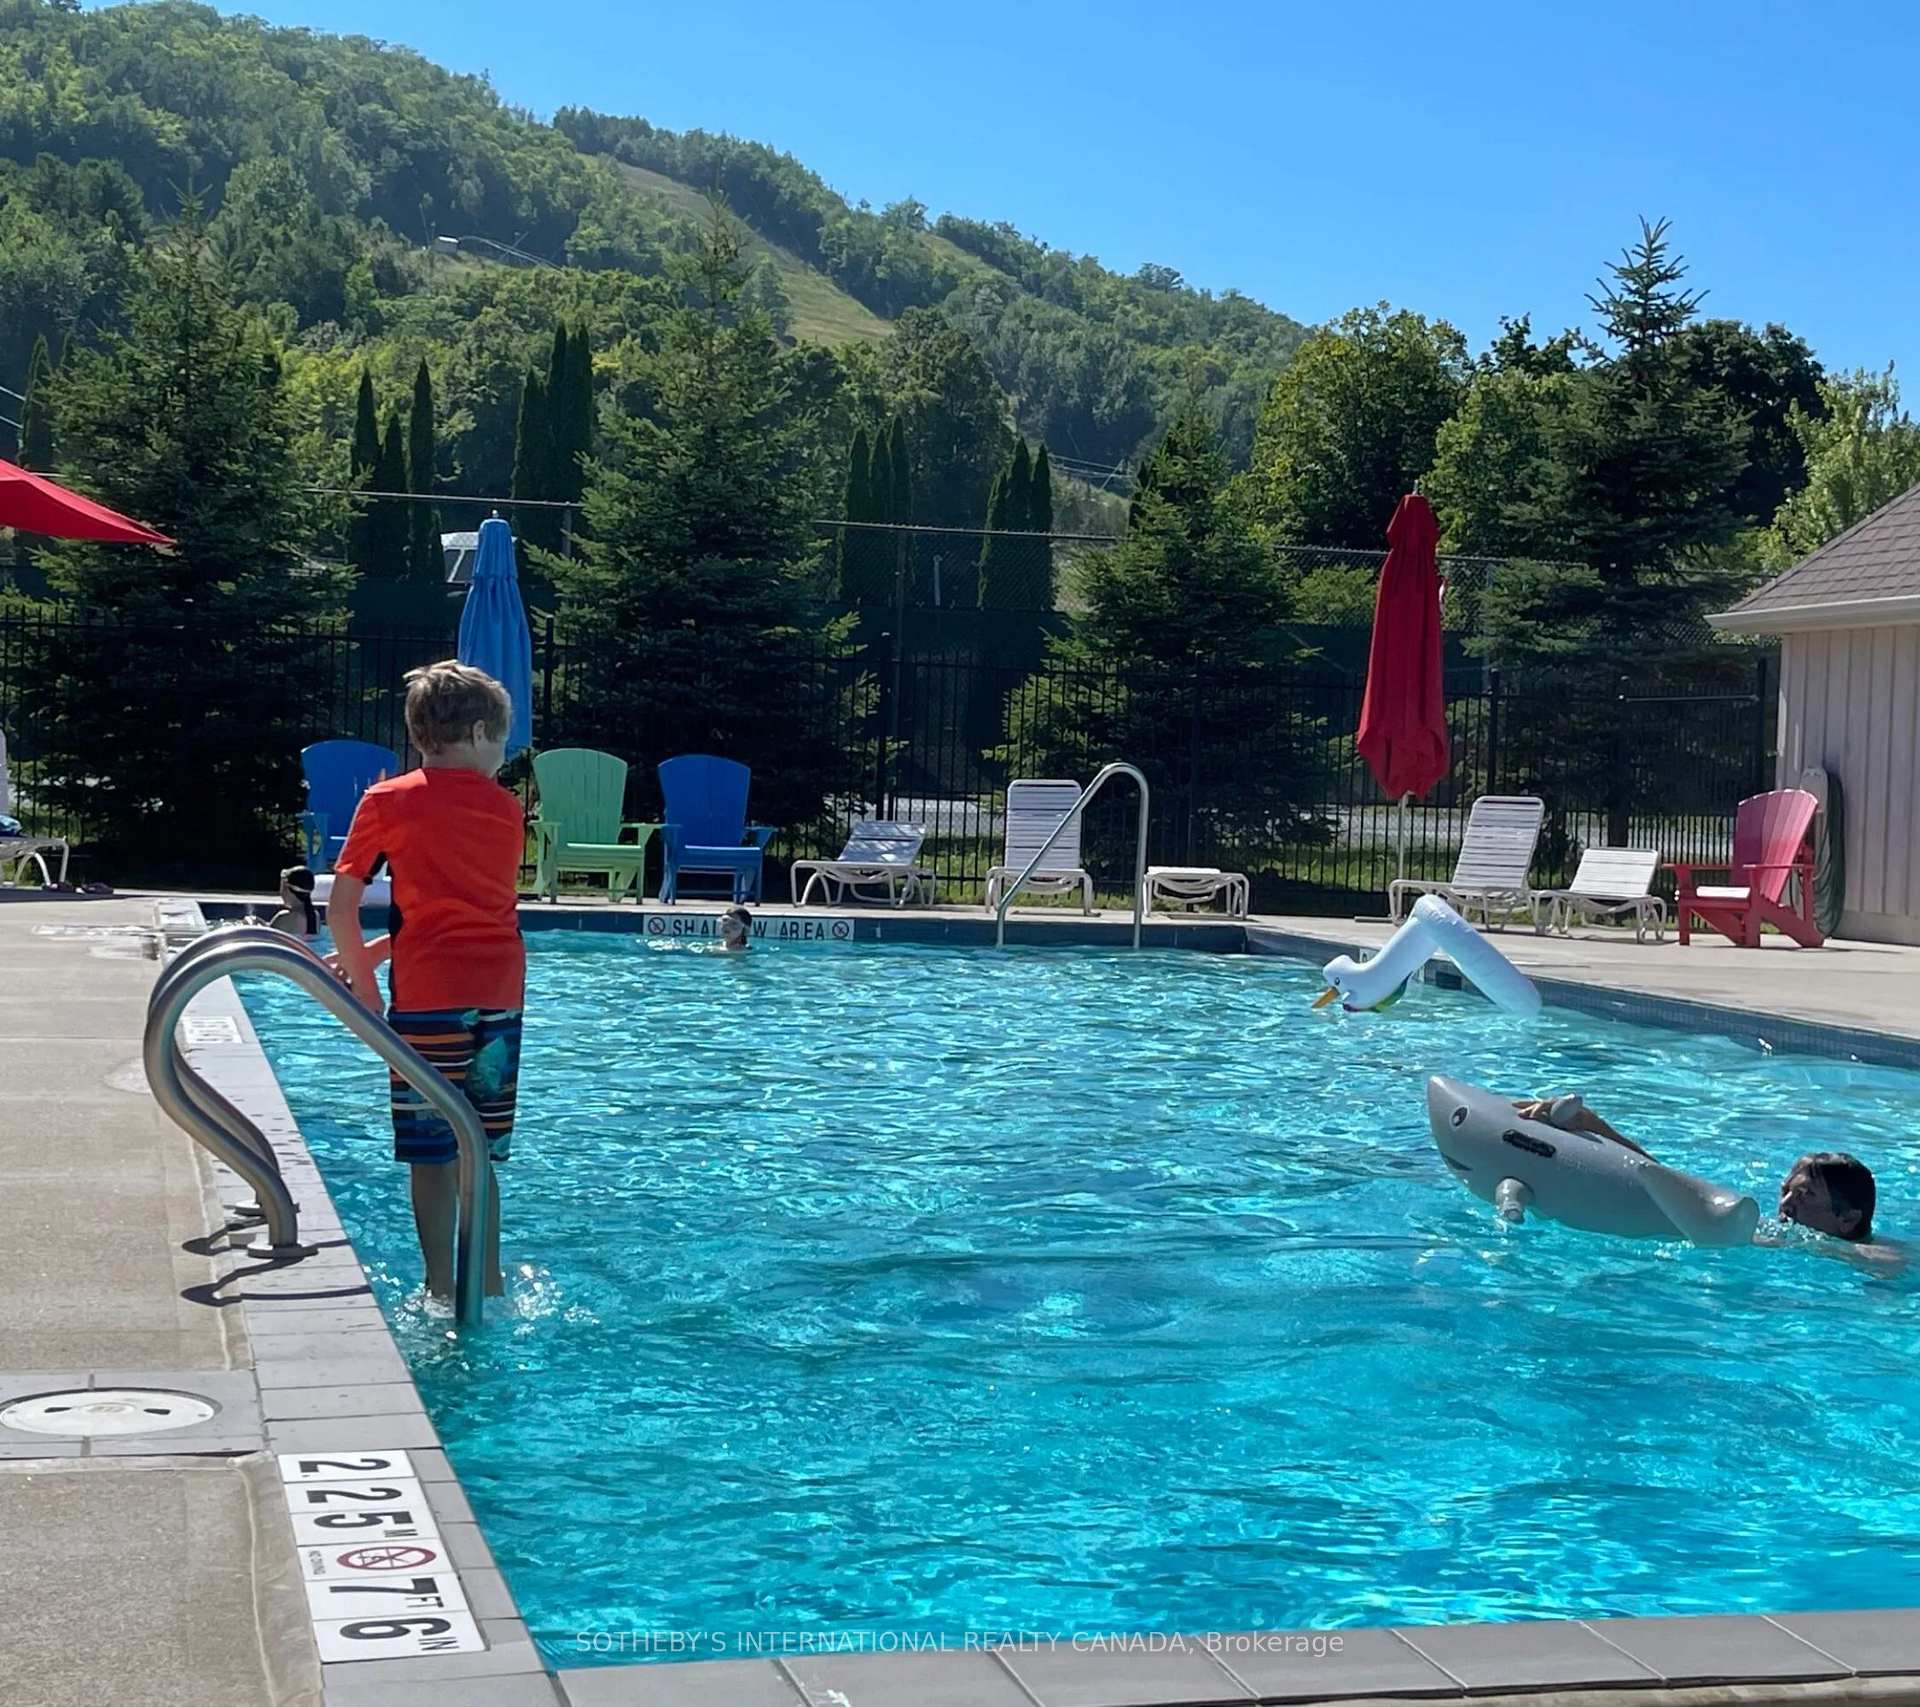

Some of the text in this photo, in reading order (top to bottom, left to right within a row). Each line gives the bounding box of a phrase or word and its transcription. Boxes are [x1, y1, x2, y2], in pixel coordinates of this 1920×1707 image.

[779, 921, 825, 941] AREA
[329, 1577, 460, 1651] 7 FT 6 IN
